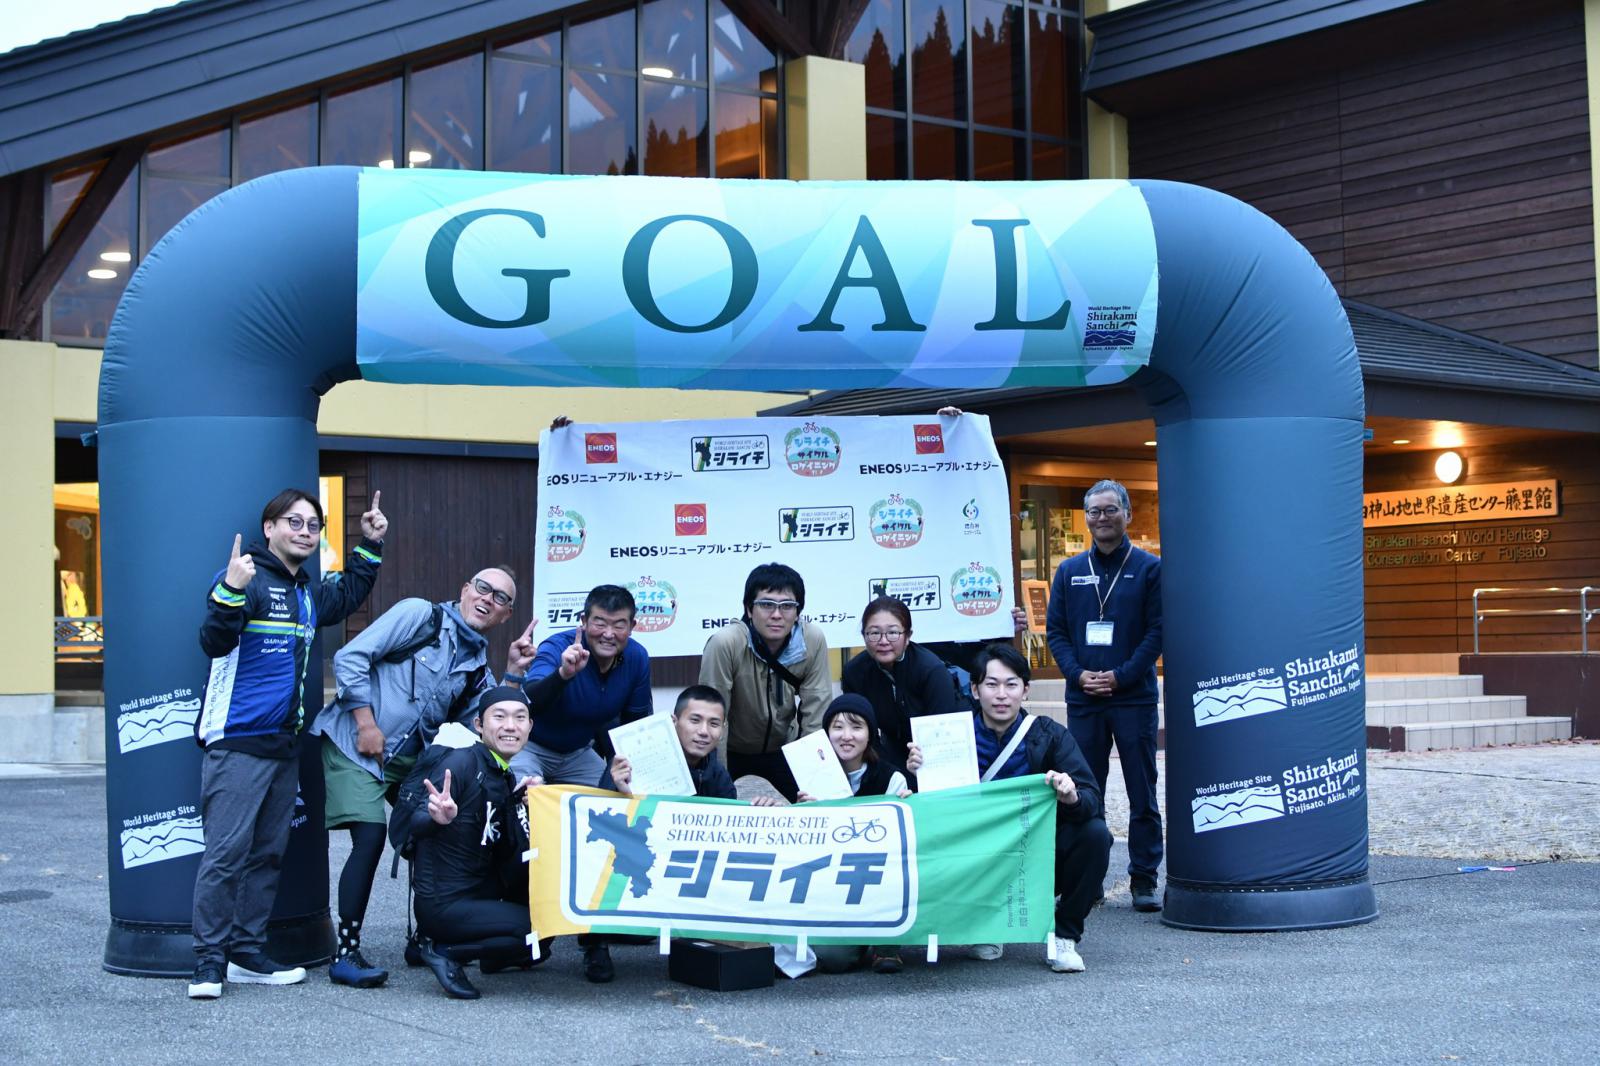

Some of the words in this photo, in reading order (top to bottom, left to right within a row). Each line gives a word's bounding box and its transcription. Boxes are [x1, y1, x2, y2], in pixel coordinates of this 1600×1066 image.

[425, 207, 1071, 333] GOAL
[1087, 311, 1138, 321] Shirakami
[1086, 321, 1119, 330] Sanchi
[794, 437, 830, 447] シライチ
[713, 451, 765, 466] シライチ
[797, 450, 829, 459] サイクル
[677, 515, 704, 523] ENEOS
[879, 509, 913, 519] シライチ
[800, 522, 849, 537] シライチ
[882, 522, 912, 531] サイクル
[1462, 528, 1495, 544] World
[1500, 527, 1550, 543] Heritage
[1367, 550, 1440, 567] Conservation
[1498, 545, 1547, 562] Fujisato
[960, 577, 993, 587] シライチ
[962, 590, 992, 599] サイクル
[547, 609, 584, 623] シライ
[1285, 643, 1358, 679] Shirakami
[1196, 677, 1219, 690] World
[1221, 669, 1256, 684] Heritage
[1257, 667, 1275, 677] Site
[1288, 668, 1343, 697] Sanchi
[120, 699, 139, 713] World
[140, 692, 173, 707] Heritage
[174, 688, 192, 699] Site
[1291, 692, 1328, 707] Fujisato,
[1282, 749, 1358, 786] Shirakami
[1195, 784, 1218, 796] World
[1219, 777, 1254, 791] Heritage
[1255, 774, 1272, 784] Site
[1285, 774, 1343, 805] Sanchi
[1288, 797, 1326, 815] Fujisato,
[123, 815, 142, 828] World
[143, 808, 176, 823] Heritage
[177, 805, 196, 815] Site
[291, 814, 307, 828] apan
[671, 812, 723, 828] WORLD
[726, 814, 796, 829] HERITAGE
[798, 815, 830, 829] SITE
[666, 828, 827, 845] SHIRAKAMI-SANCHI
[663, 849, 889, 905] シライチ
